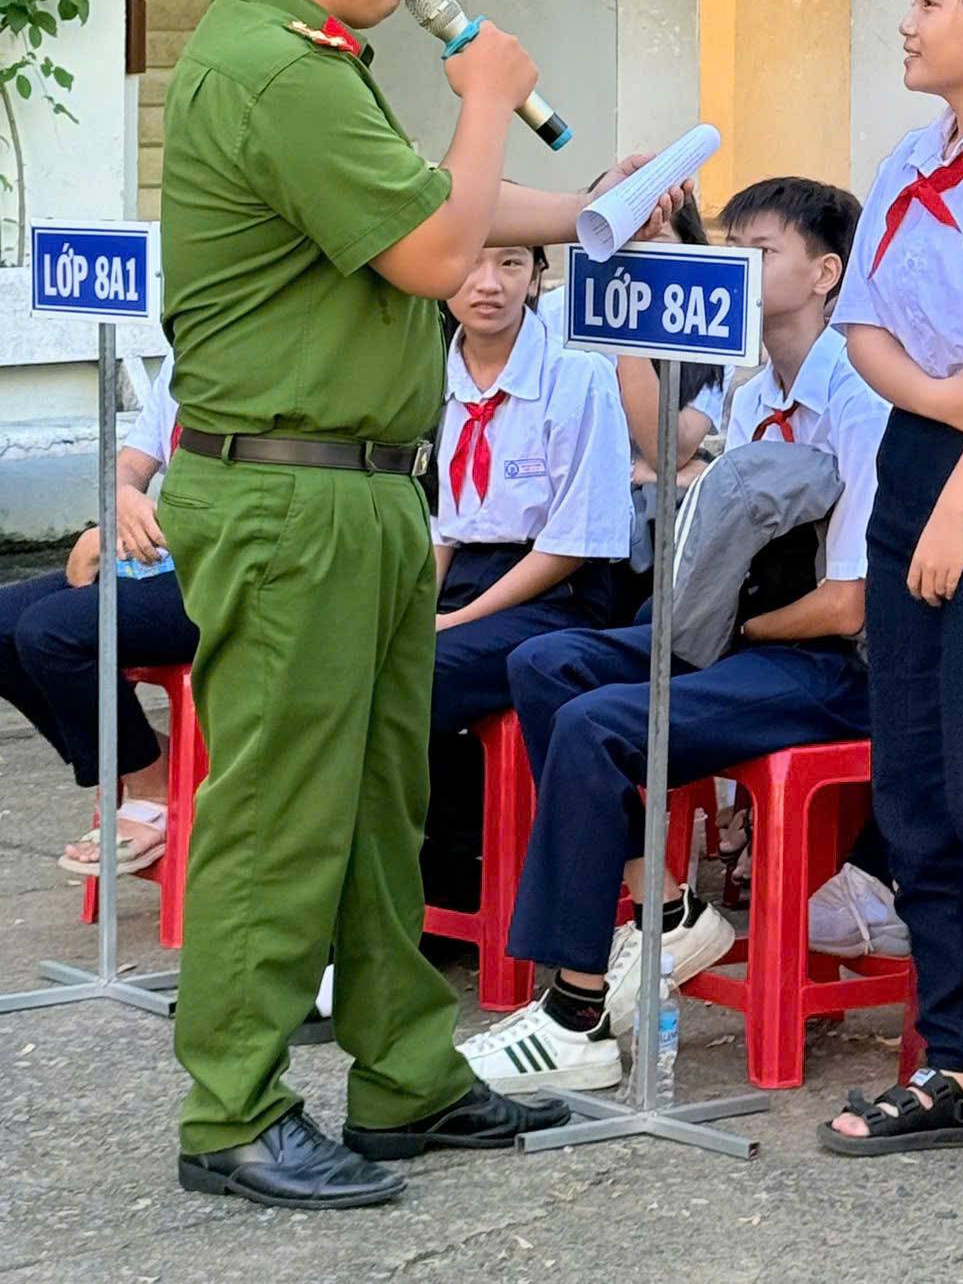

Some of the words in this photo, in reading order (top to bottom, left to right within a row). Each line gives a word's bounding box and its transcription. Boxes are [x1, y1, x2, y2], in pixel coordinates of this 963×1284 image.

[44, 243, 88, 298] LỚP
[95, 254, 138, 300] 8A1
[585, 267, 651, 330] LỚP
[662, 283, 730, 338] 8A2
